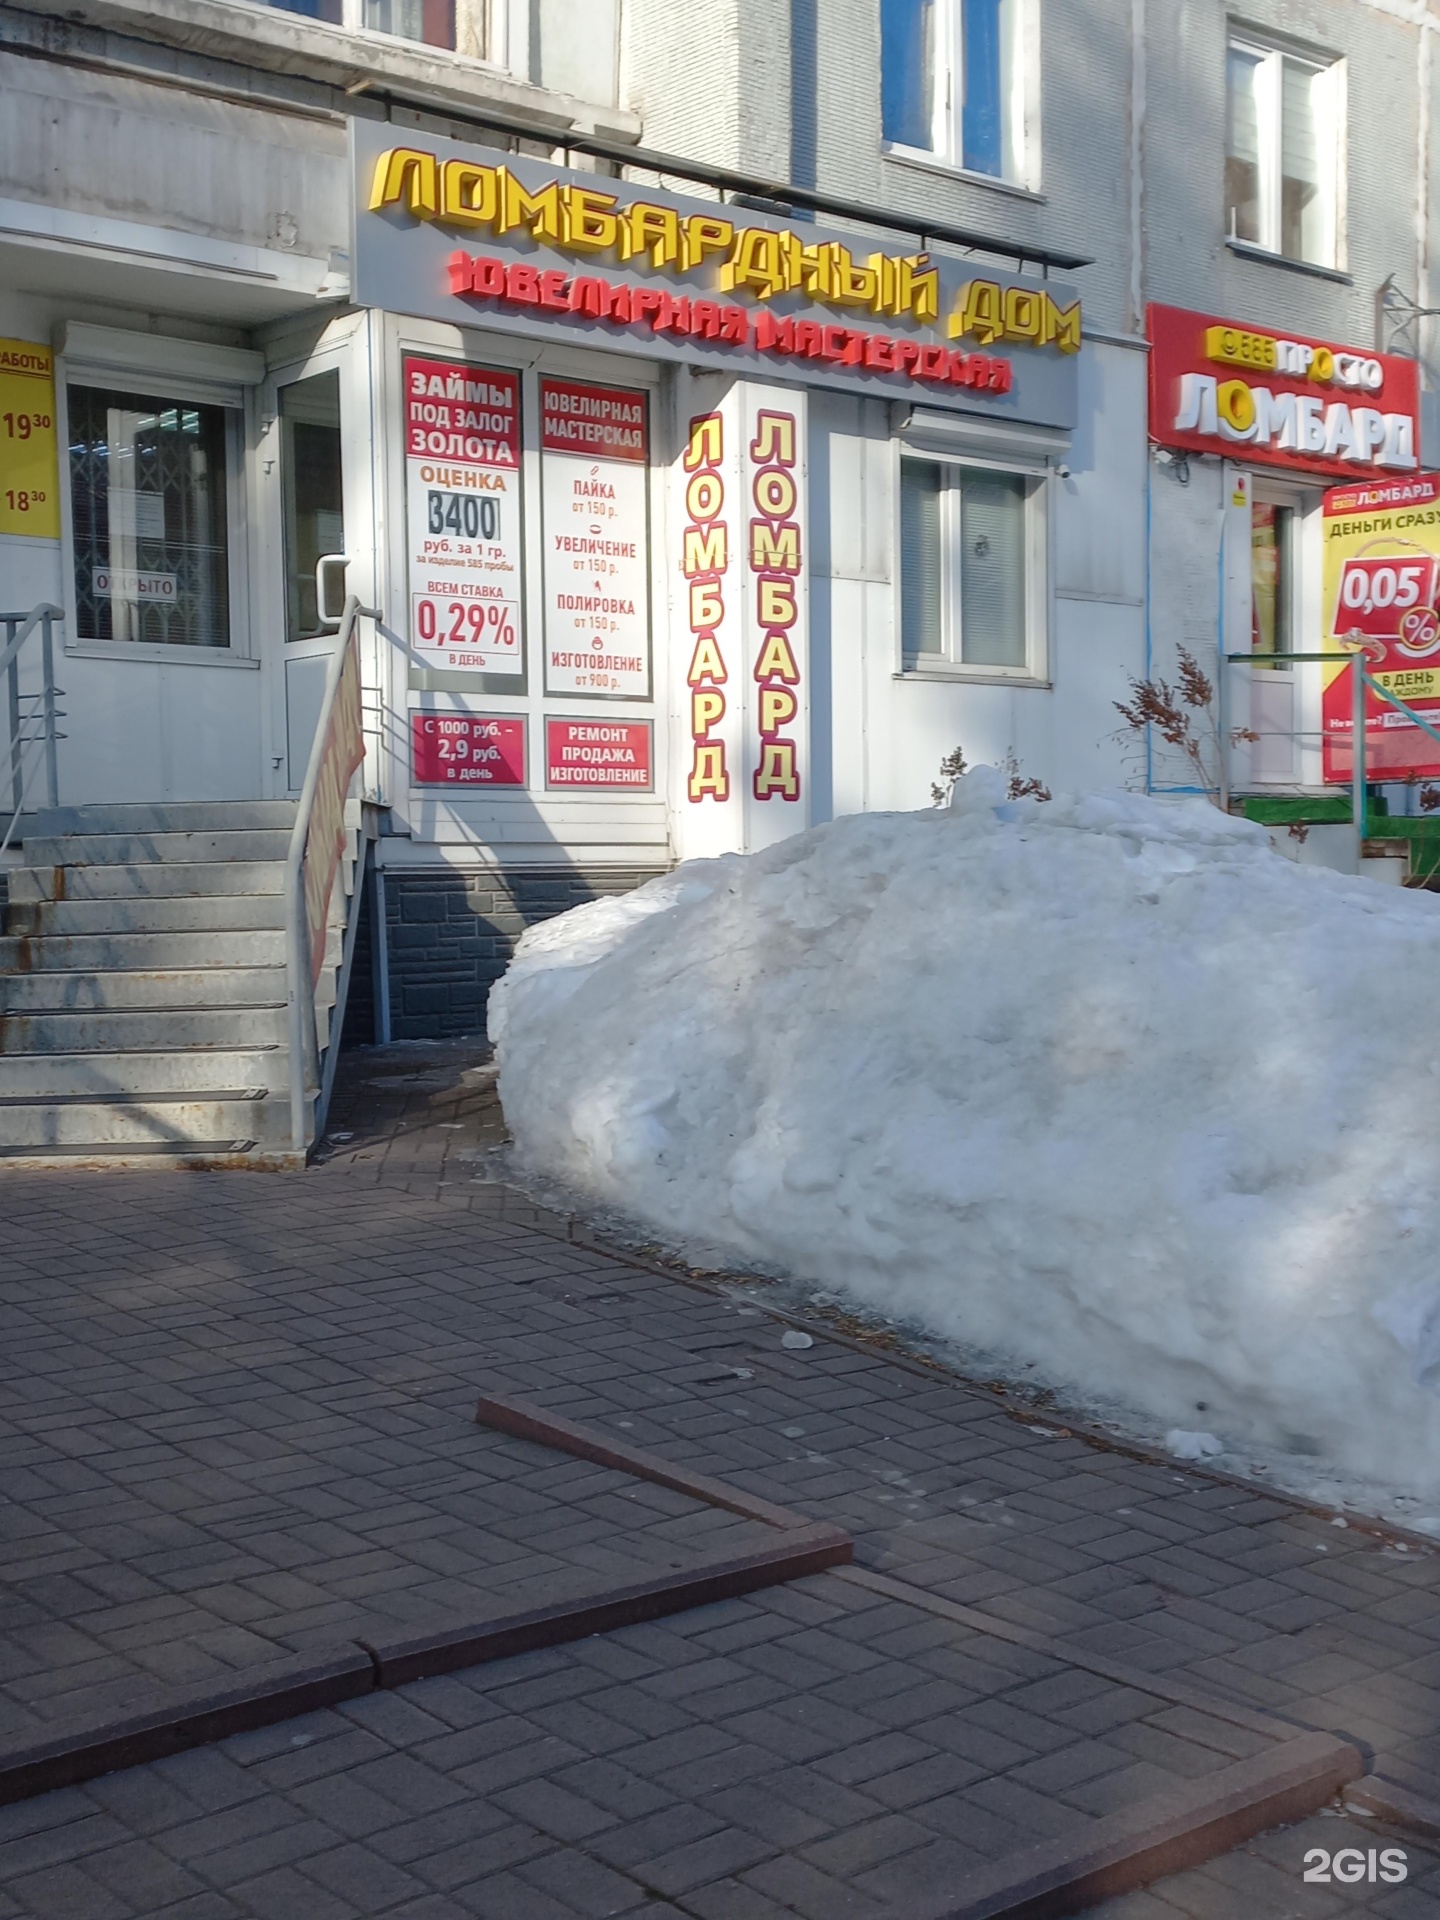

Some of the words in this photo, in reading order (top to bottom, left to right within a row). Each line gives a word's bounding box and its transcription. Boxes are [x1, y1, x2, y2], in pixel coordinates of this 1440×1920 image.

[368, 146, 938, 319] ЛОМБАРДНЫЙ
[947, 276, 1082, 353] ДОМ
[447, 249, 751, 344] ЮВЕЛИРНАЯ
[755, 309, 1014, 396] МАСТЕРСКАЯ
[0, 351, 49, 371] АБОТЫ
[1276, 340, 1384, 388] ПРОСТО
[410, 371, 513, 408] ЗАЙМЫ
[410, 401, 450, 429] ПОД
[455, 408, 513, 434] ЗАЛОГ
[544, 391, 642, 423] ЮВЕЛИРНАЯ
[1174, 372, 1418, 469] ЛОМБАРД
[544, 416, 643, 448] МАСТЕРСКАЯ
[411, 429, 514, 463] ЗОЛОТА
[420, 466, 507, 491] ОЦЕНКА
[573, 479, 616, 499] ПАЙКА
[1357, 483, 1434, 506] ЛОМБАРД
[429, 492, 496, 540] 3400
[572, 502, 584, 512] от
[587, 501, 606, 516] 150
[608, 506, 618, 519] р.
[1330, 518, 1392, 538] ДЕНЬГИ
[424, 539, 452, 554] руб.
[457, 544, 472, 554] за
[477, 544, 483, 555] 1
[488, 547, 506, 560] гр.
[555, 535, 637, 558] УВЕЛИЧЕНИЕ
[416, 555, 426, 563] за
[428, 556, 466, 567] изделие
[484, 561, 514, 571] пробы
[573, 559, 585, 570] от
[588, 559, 606, 573] 150
[609, 563, 619, 576] р.
[428, 581, 458, 594] ВСЕМ
[461, 584, 503, 598] СТАВКА
[557, 594, 635, 614] ПОЛИРОВКА
[683, 410, 729, 803] ЛОМБАРД
[750, 408, 800, 802] ЛОМБАРД
[1343, 567, 1425, 615] 0,05
[1405, 613, 1435, 642] %
[418, 600, 514, 646] 0,29%
[574, 617, 586, 628] от
[589, 616, 607, 630] 150
[610, 620, 620, 633] р.
[449, 654, 456, 664] В
[458, 655, 485, 666] ДЕНЬ
[552, 651, 642, 672] ИЗГОТОВЛЕНИЕ
[575, 674, 586, 685] от
[589, 674, 609, 687] 900
[611, 677, 621, 690] р.
[1383, 675, 1390, 686] В
[1394, 672, 1434, 687] ДЕНЬ
[1387, 686, 1434, 697] АЖДОМУ
[437, 721, 469, 734] 1000
[473, 722, 501, 738] руб.
[568, 726, 628, 742] РЕМОНТ
[437, 739, 469, 761] 2,9
[472, 746, 501, 762] руб.
[562, 746, 635, 764] ПРОДАЖА
[447, 768, 456, 778] в
[459, 768, 493, 780] день
[551, 766, 647, 783] ИЗГОТОВЛЕНИЕ
